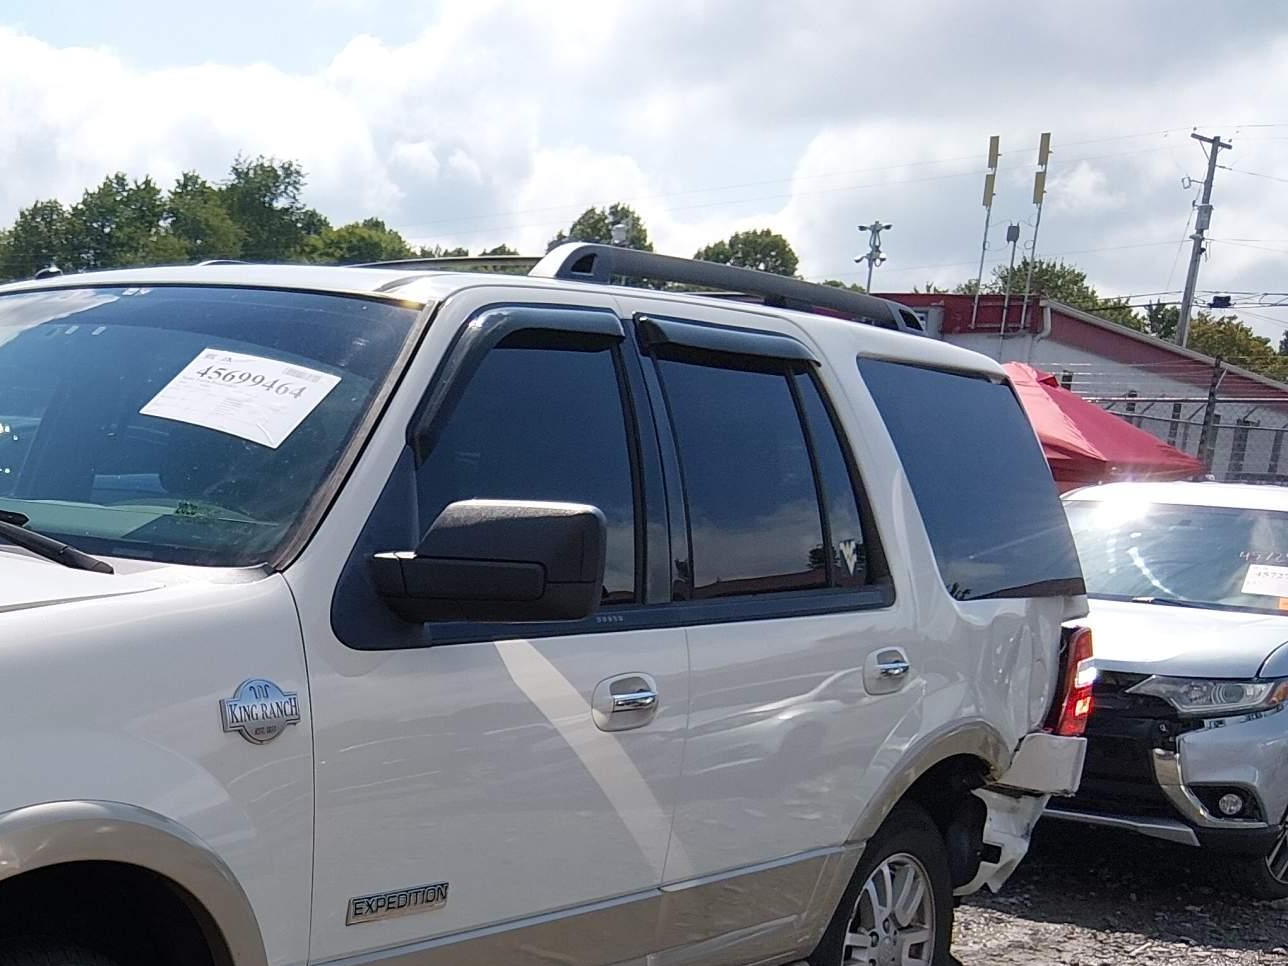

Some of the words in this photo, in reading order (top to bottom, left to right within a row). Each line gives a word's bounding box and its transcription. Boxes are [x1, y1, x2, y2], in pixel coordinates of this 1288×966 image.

[196, 365, 308, 400] 45699464
[227, 703, 259, 724] KING
[261, 697, 299, 720] RANCH
[352, 884, 449, 916] EXPEDITION
